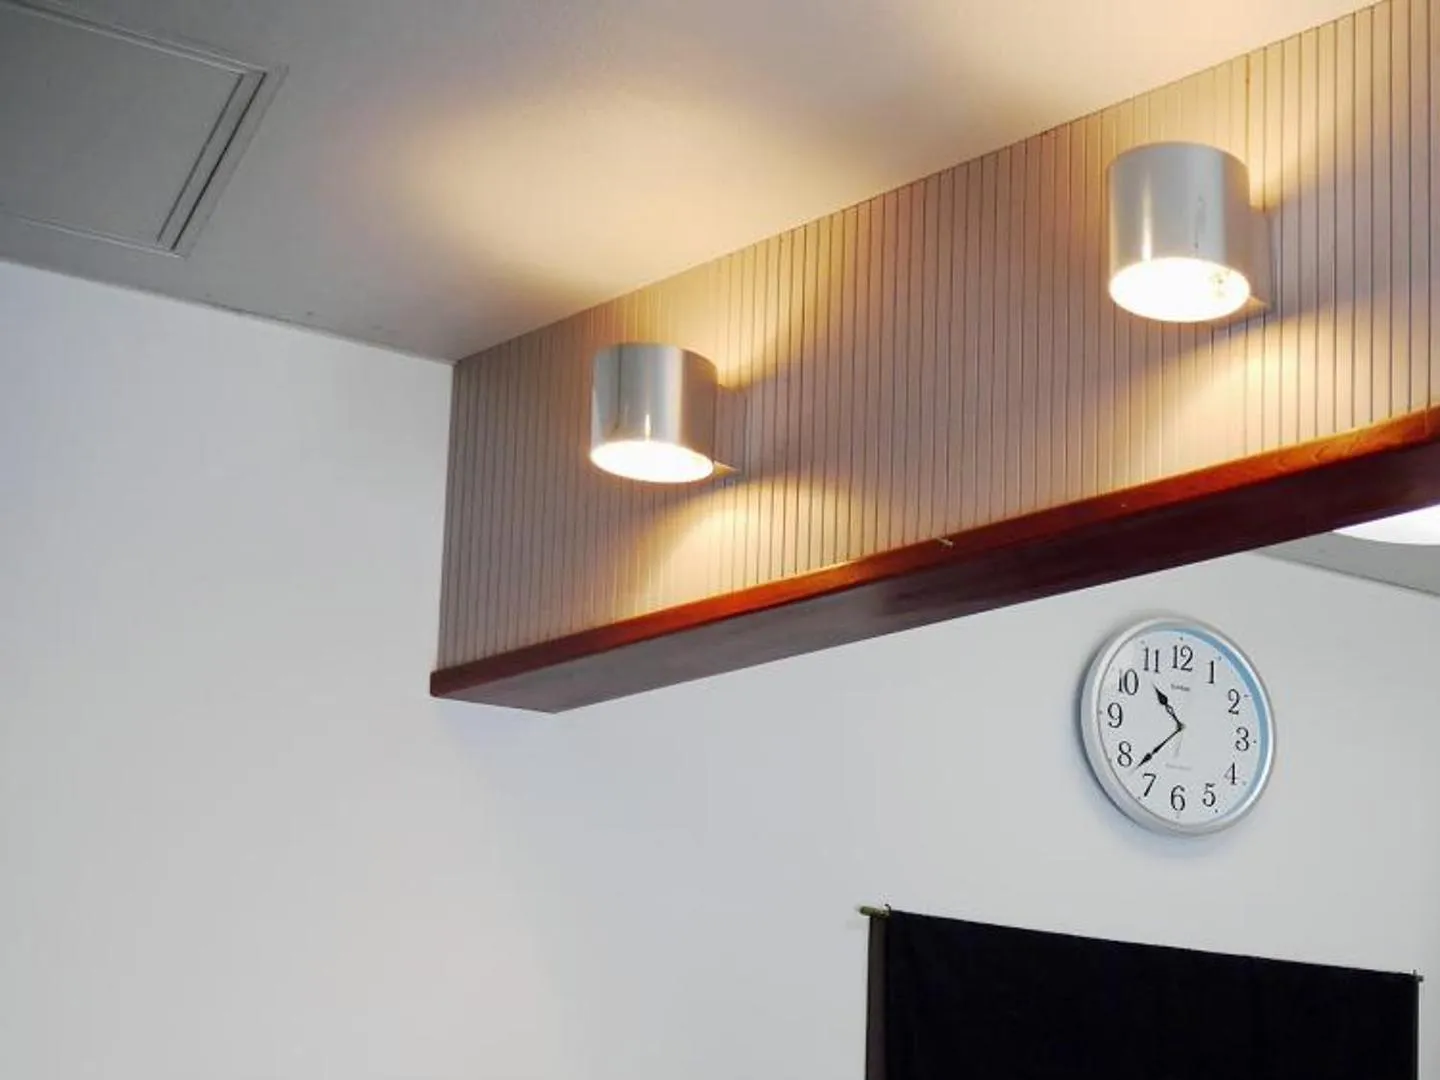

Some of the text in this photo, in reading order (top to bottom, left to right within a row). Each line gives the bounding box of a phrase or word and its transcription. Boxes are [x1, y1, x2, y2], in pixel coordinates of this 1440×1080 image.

[1143, 647, 1160, 673] 11
[1172, 645, 1194, 672] 12
[1118, 668, 1139, 695] 10
[1207, 660, 1215, 684] 1
[1228, 688, 1240, 715] 2
[1107, 702, 1123, 728] 9
[1235, 726, 1250, 751] 3
[1117, 740, 1132, 768] 8
[1142, 772, 1157, 797] 7
[1224, 762, 1237, 786] 4
[1170, 785, 1185, 811] 6
[1202, 782, 1216, 807] 5
